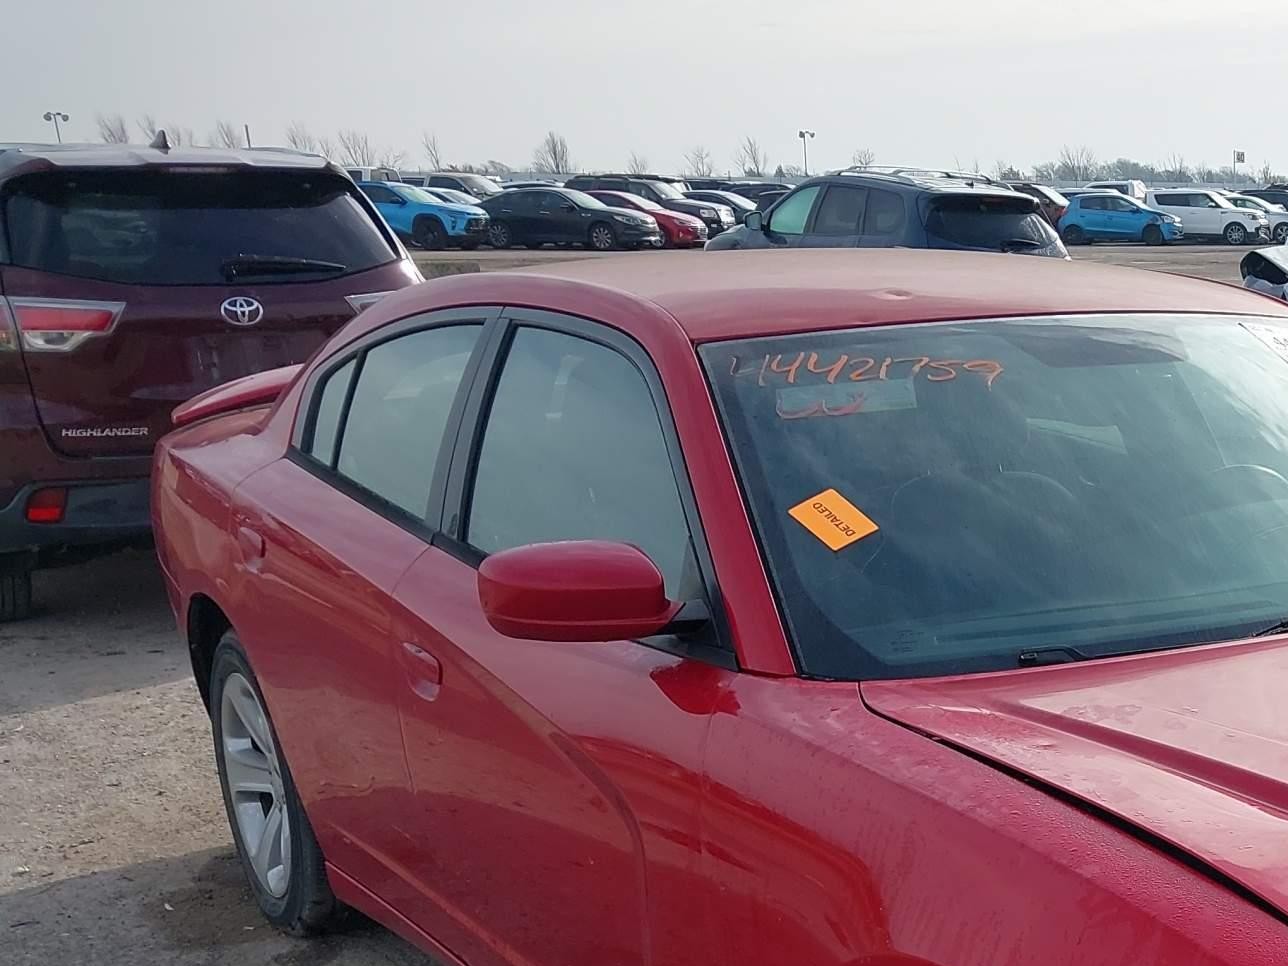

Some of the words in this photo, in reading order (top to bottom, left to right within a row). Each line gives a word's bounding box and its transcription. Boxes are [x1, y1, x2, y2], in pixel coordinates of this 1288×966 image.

[729, 351, 1004, 391] 44421759
[61, 427, 149, 437] HIGHLANDER
[812, 502, 857, 537] DETAILED
